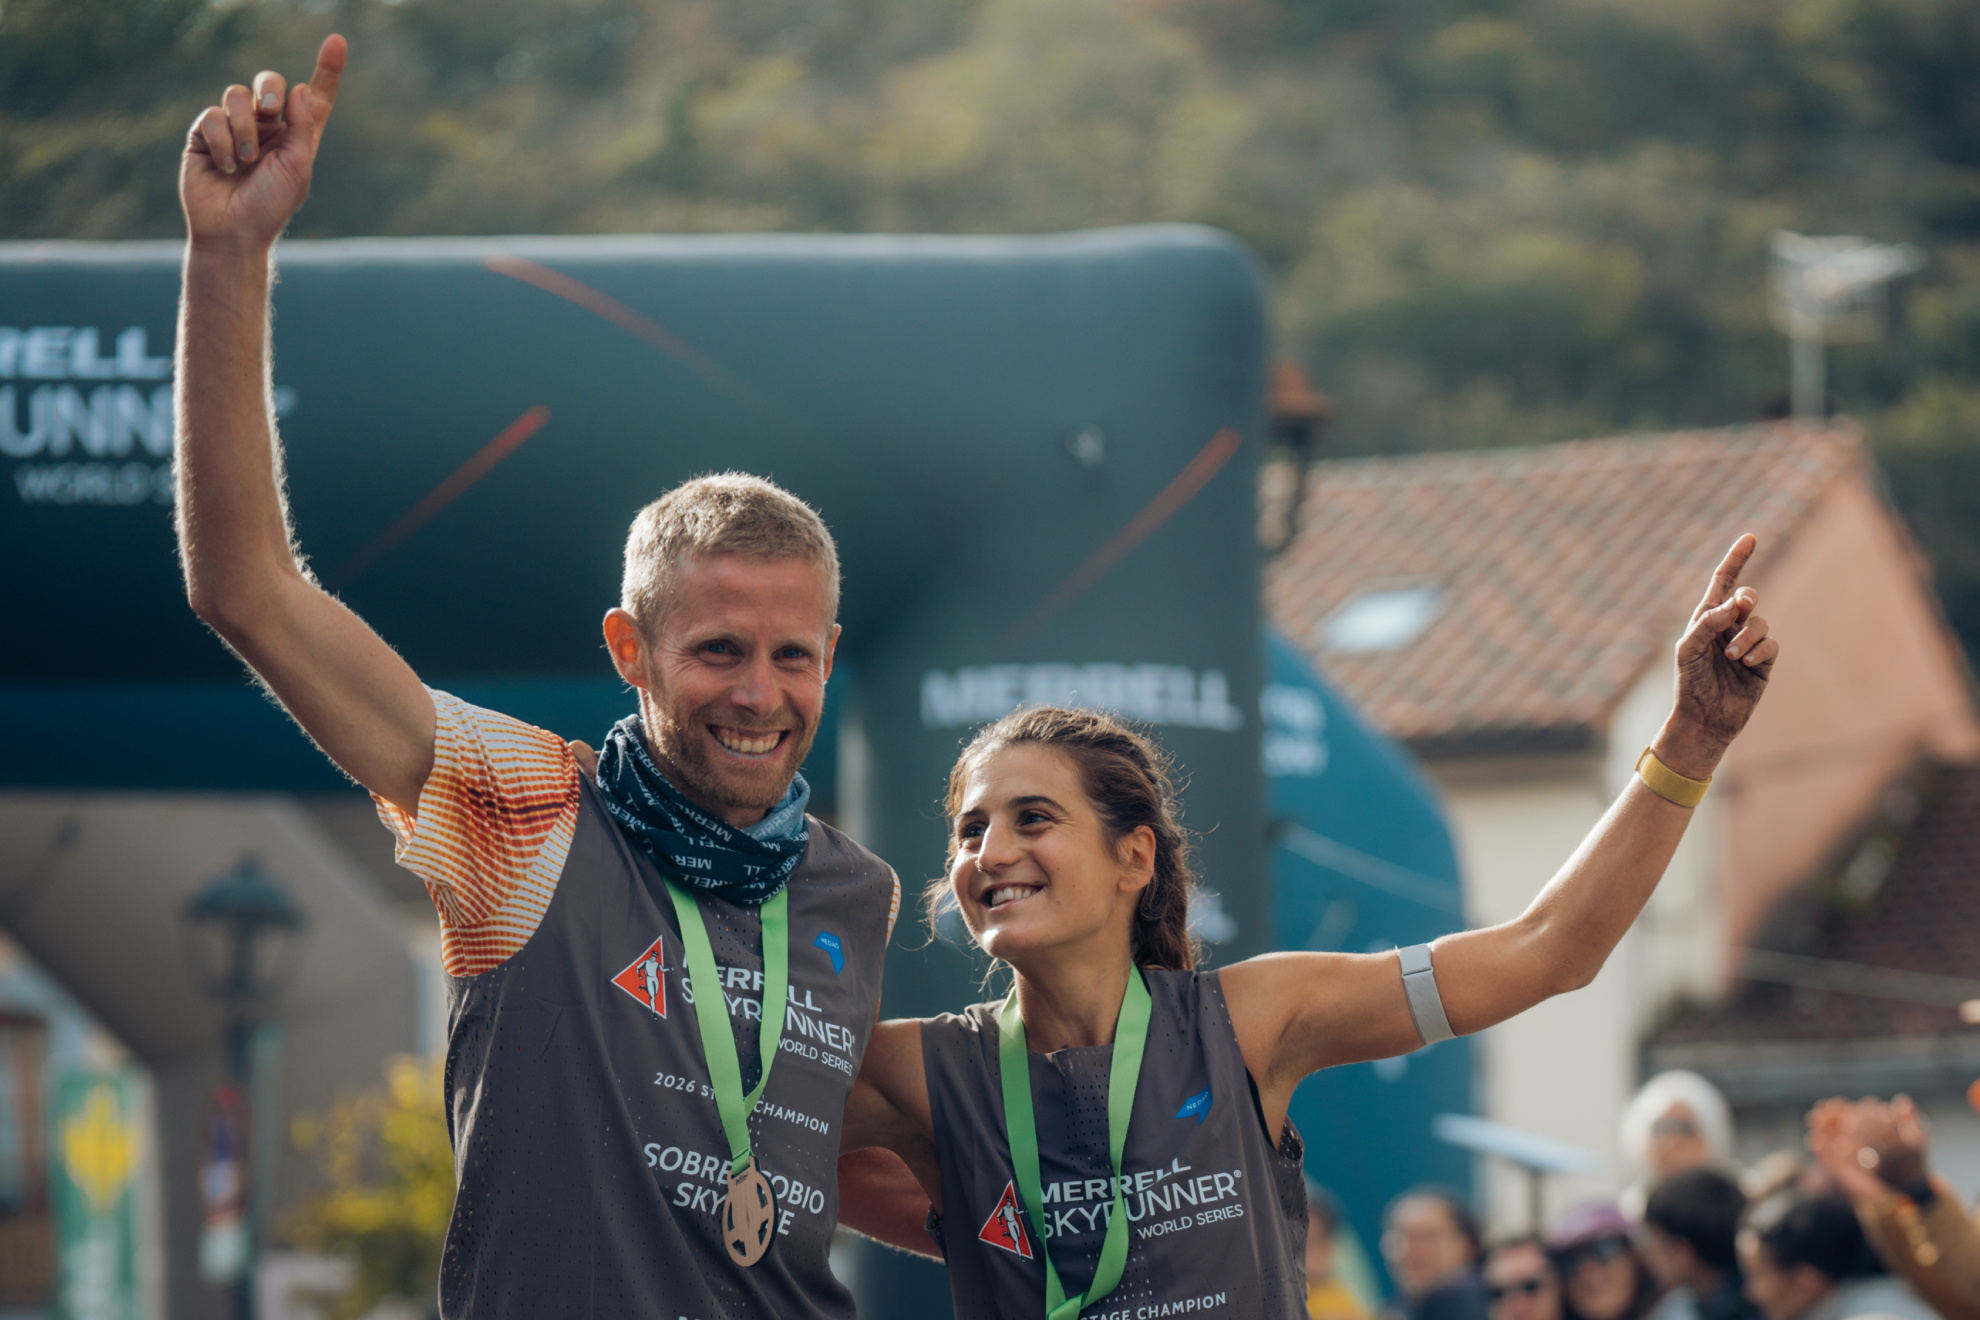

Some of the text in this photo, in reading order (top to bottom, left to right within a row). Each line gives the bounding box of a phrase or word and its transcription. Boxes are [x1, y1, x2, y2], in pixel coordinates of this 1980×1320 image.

[821, 1051, 854, 1077] SERIES
[653, 1072, 696, 1093] 2026
[753, 1101, 830, 1135] CHAMPION
[1137, 1203, 1244, 1240] WORLD SERIES
[1137, 1291, 1227, 1320] CHAMPION
